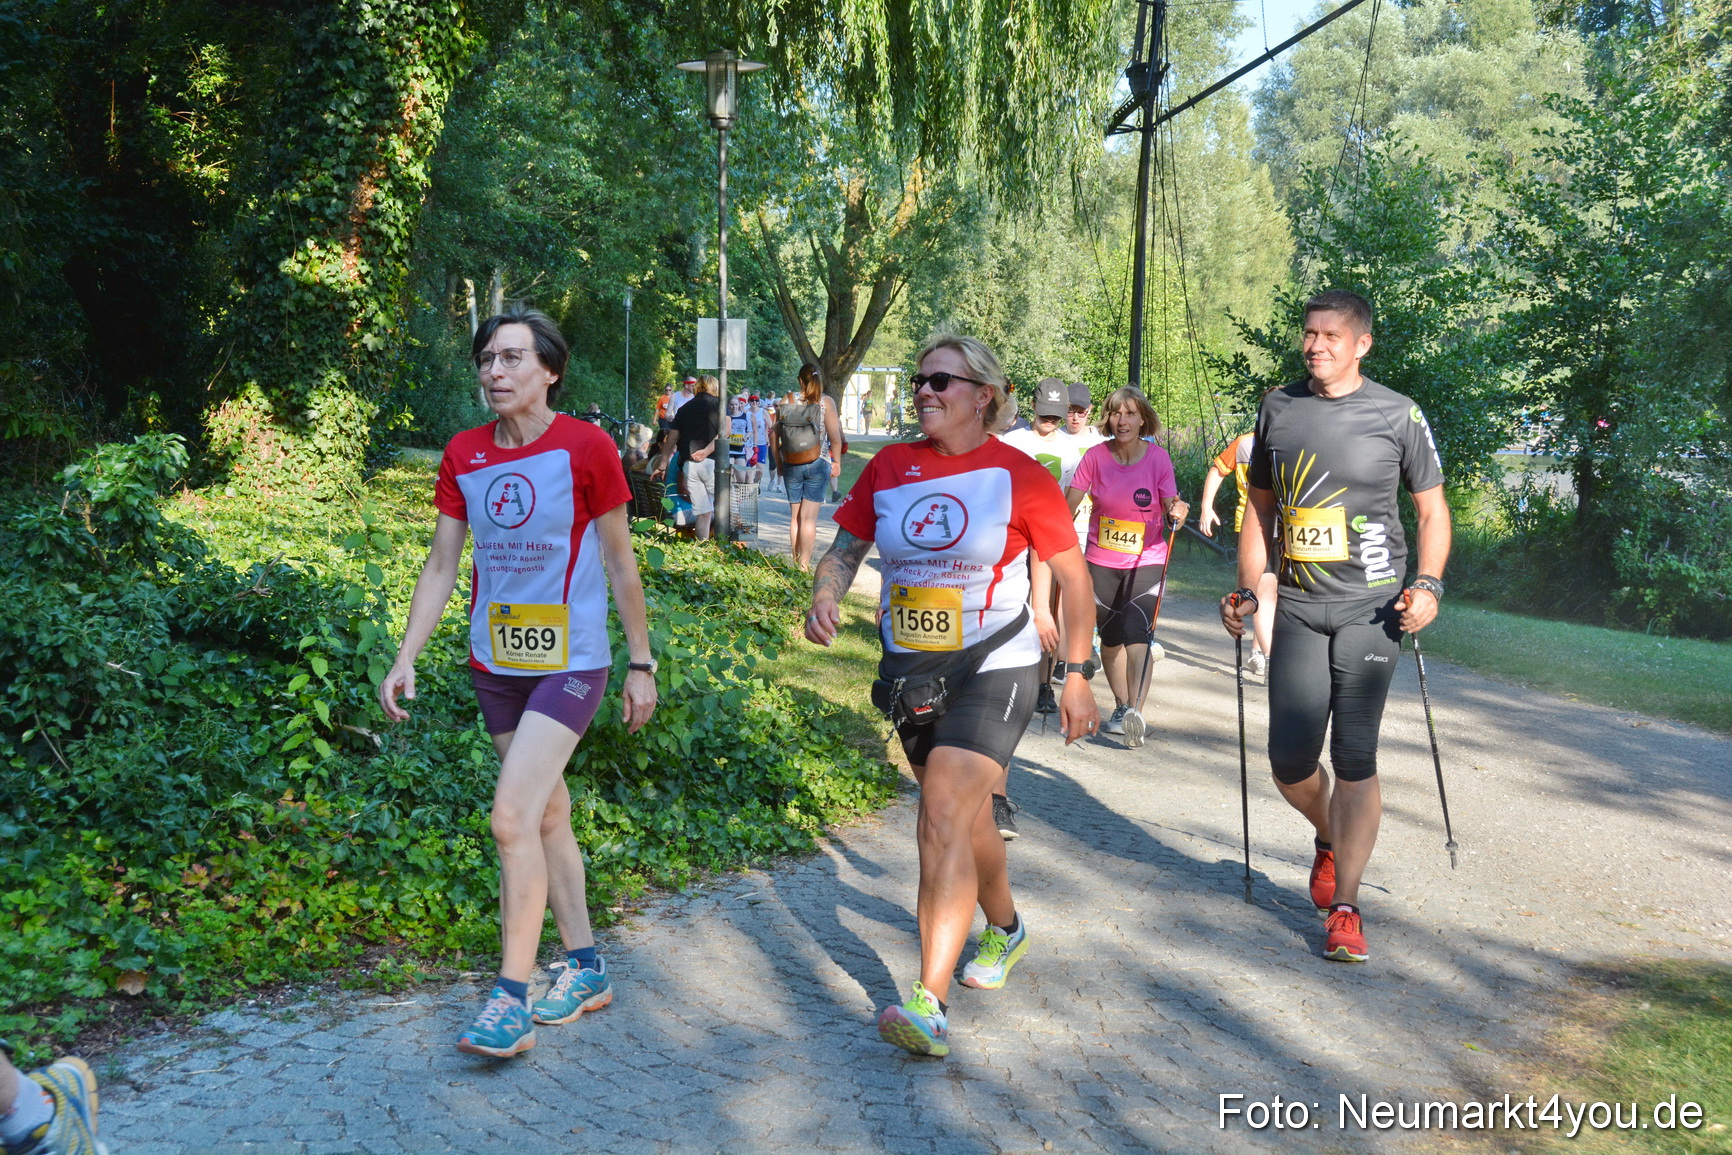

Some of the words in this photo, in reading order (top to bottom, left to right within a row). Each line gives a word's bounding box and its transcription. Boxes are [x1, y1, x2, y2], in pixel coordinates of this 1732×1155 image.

[1105, 529, 1137, 545] 1444
[1288, 526, 1333, 546] 1421
[507, 541, 523, 550] MIT
[526, 541, 553, 552] HERZ
[927, 559, 949, 569] MIT
[897, 607, 950, 633] 1568
[498, 626, 556, 651] 1569
